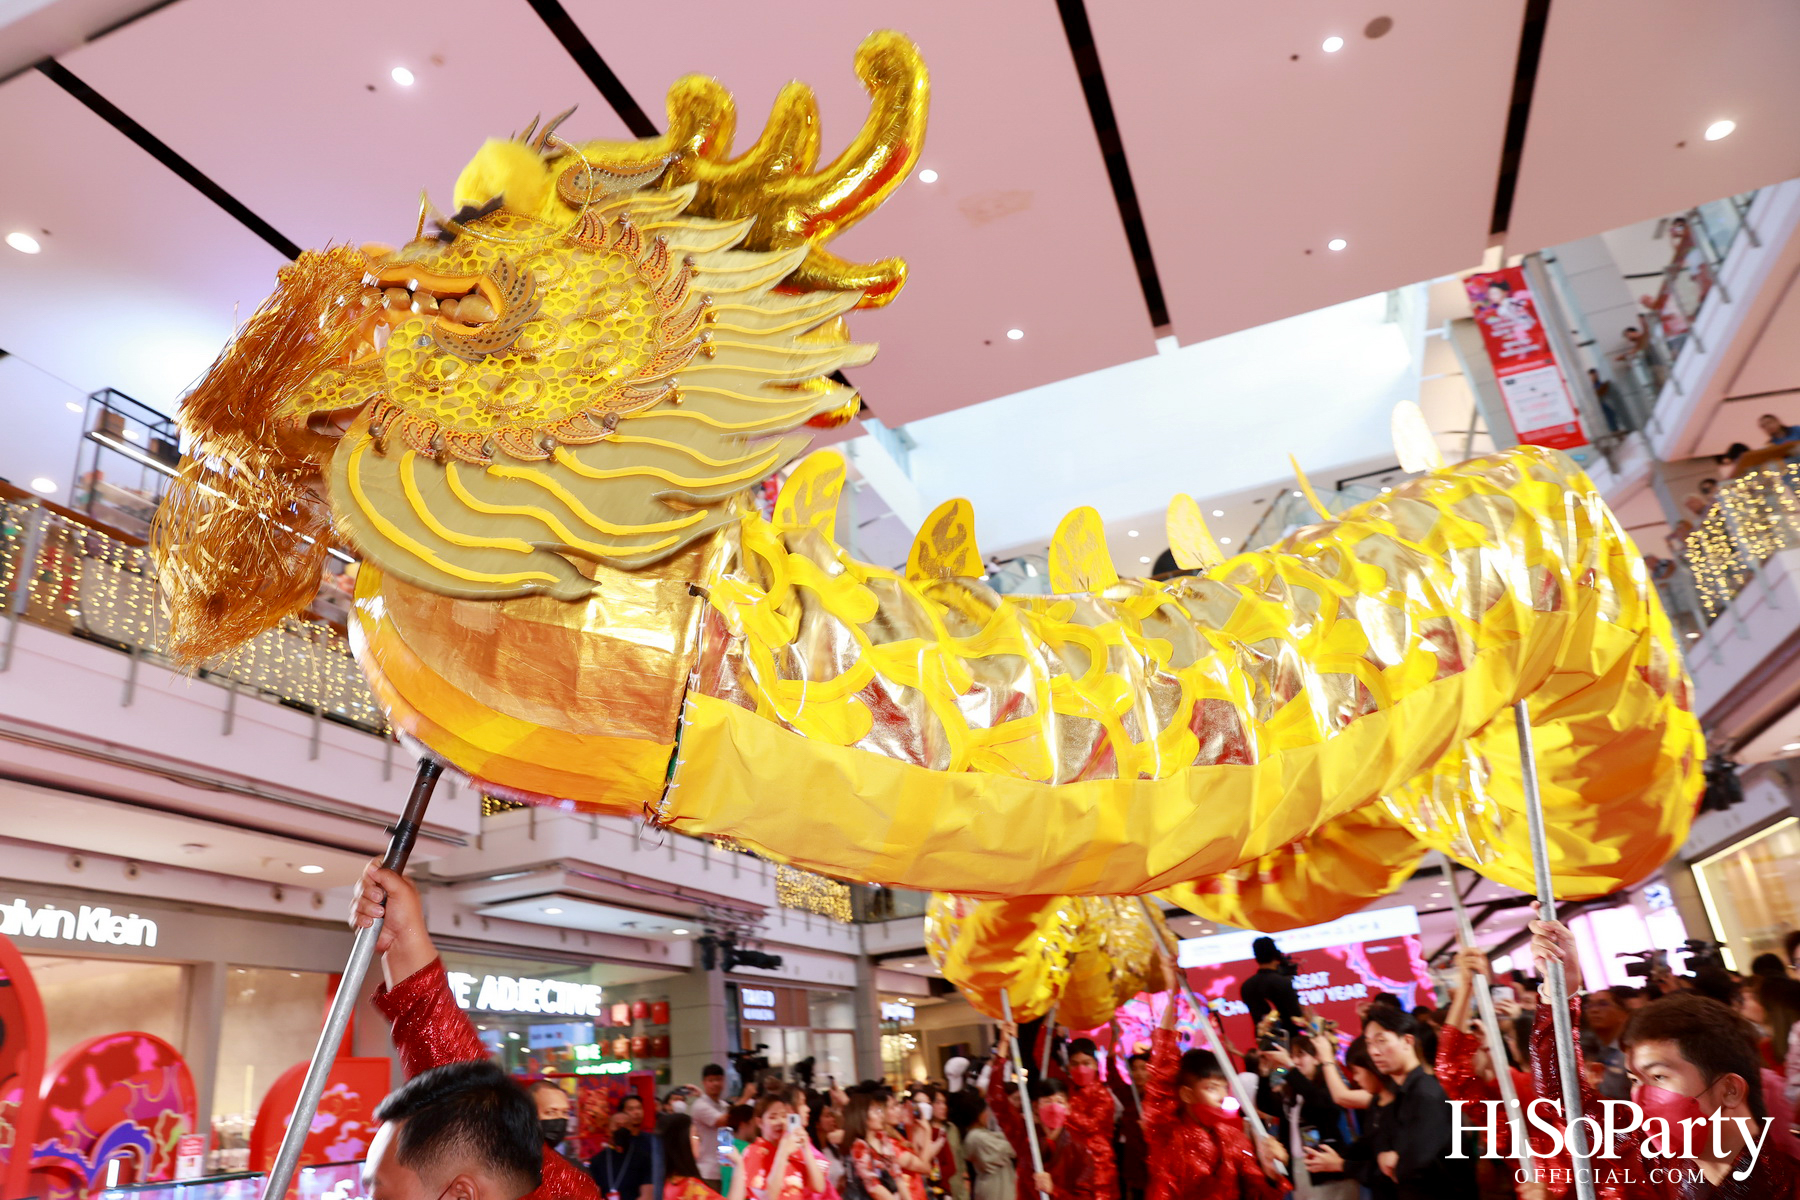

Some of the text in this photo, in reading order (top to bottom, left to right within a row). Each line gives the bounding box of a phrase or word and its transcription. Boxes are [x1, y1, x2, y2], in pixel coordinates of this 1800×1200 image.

[0, 898, 158, 947] alvin Klein
[476, 974, 602, 1016] ADJECTIVE
[1291, 972, 1330, 990] REAT
[1297, 983, 1368, 1006] EW YEAR
